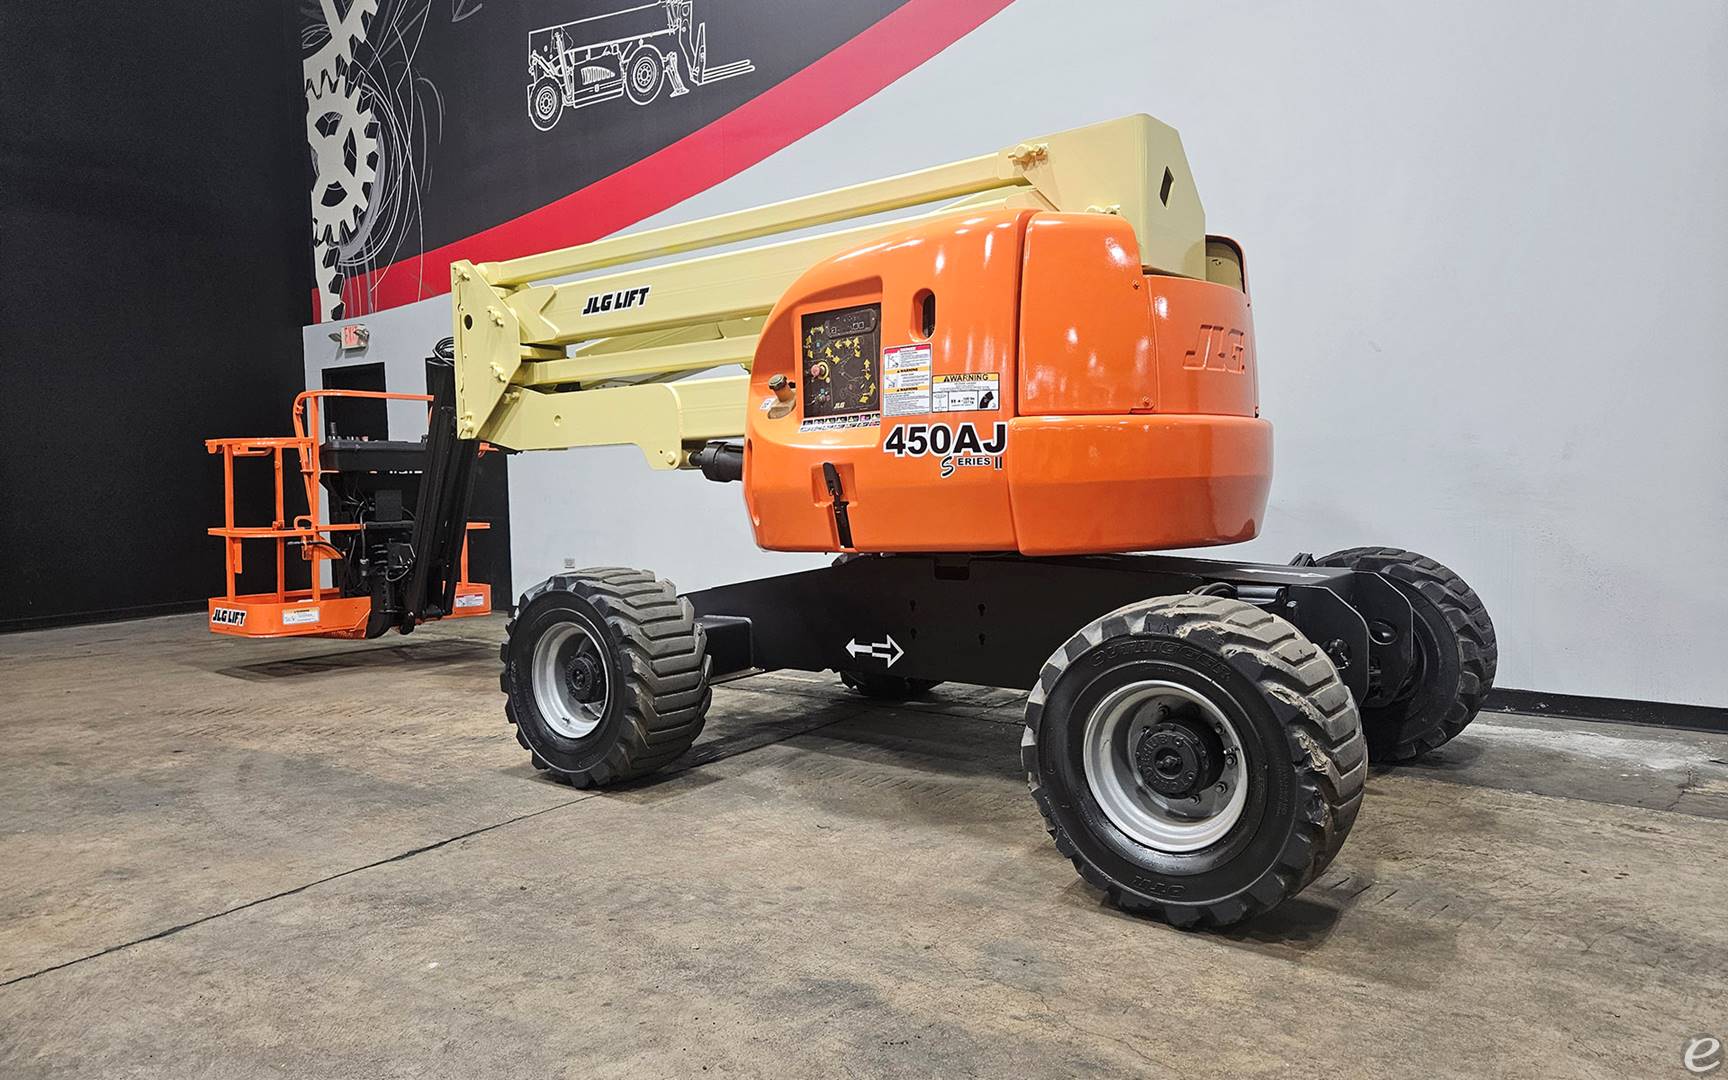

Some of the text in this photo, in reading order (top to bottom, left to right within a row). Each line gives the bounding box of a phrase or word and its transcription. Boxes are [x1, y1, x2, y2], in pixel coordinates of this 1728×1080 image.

[582, 287, 650, 315] JLG LIFT
[1182, 324, 1244, 374] JLG
[949, 374, 989, 383] WARNING
[885, 424, 1006, 455] 450AJ
[994, 457, 1002, 469] II
[212, 609, 246, 625] JLG LIFT
